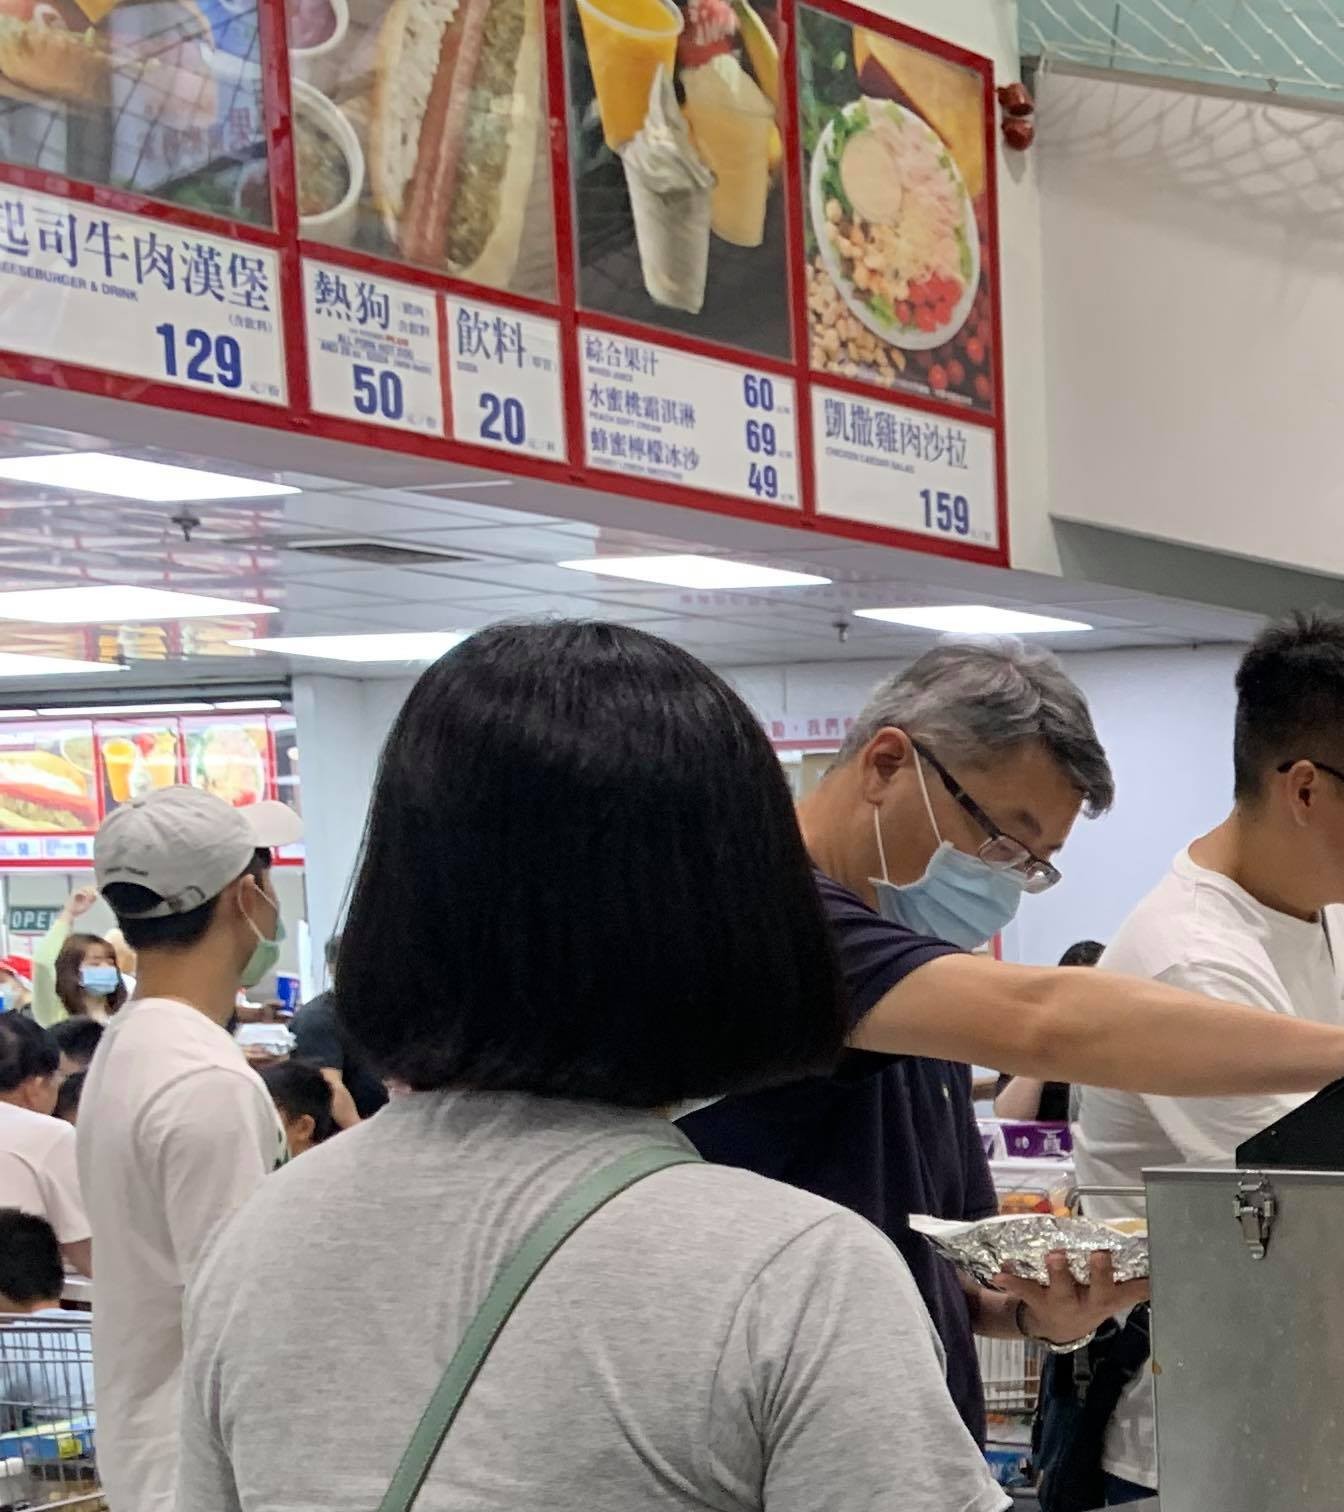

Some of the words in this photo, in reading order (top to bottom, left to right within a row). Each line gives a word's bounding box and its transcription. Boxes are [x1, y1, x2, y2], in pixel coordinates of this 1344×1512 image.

[315, 270, 389, 330] 熱狗
[156, 322, 242, 388] 129
[457, 308, 526, 368] 飲料
[353, 364, 403, 420] 50
[480, 392, 525, 445] 20
[744, 374, 774, 411] 60
[746, 419, 776, 456] 69
[748, 462, 778, 498] 49
[919, 488, 970, 535] 159
